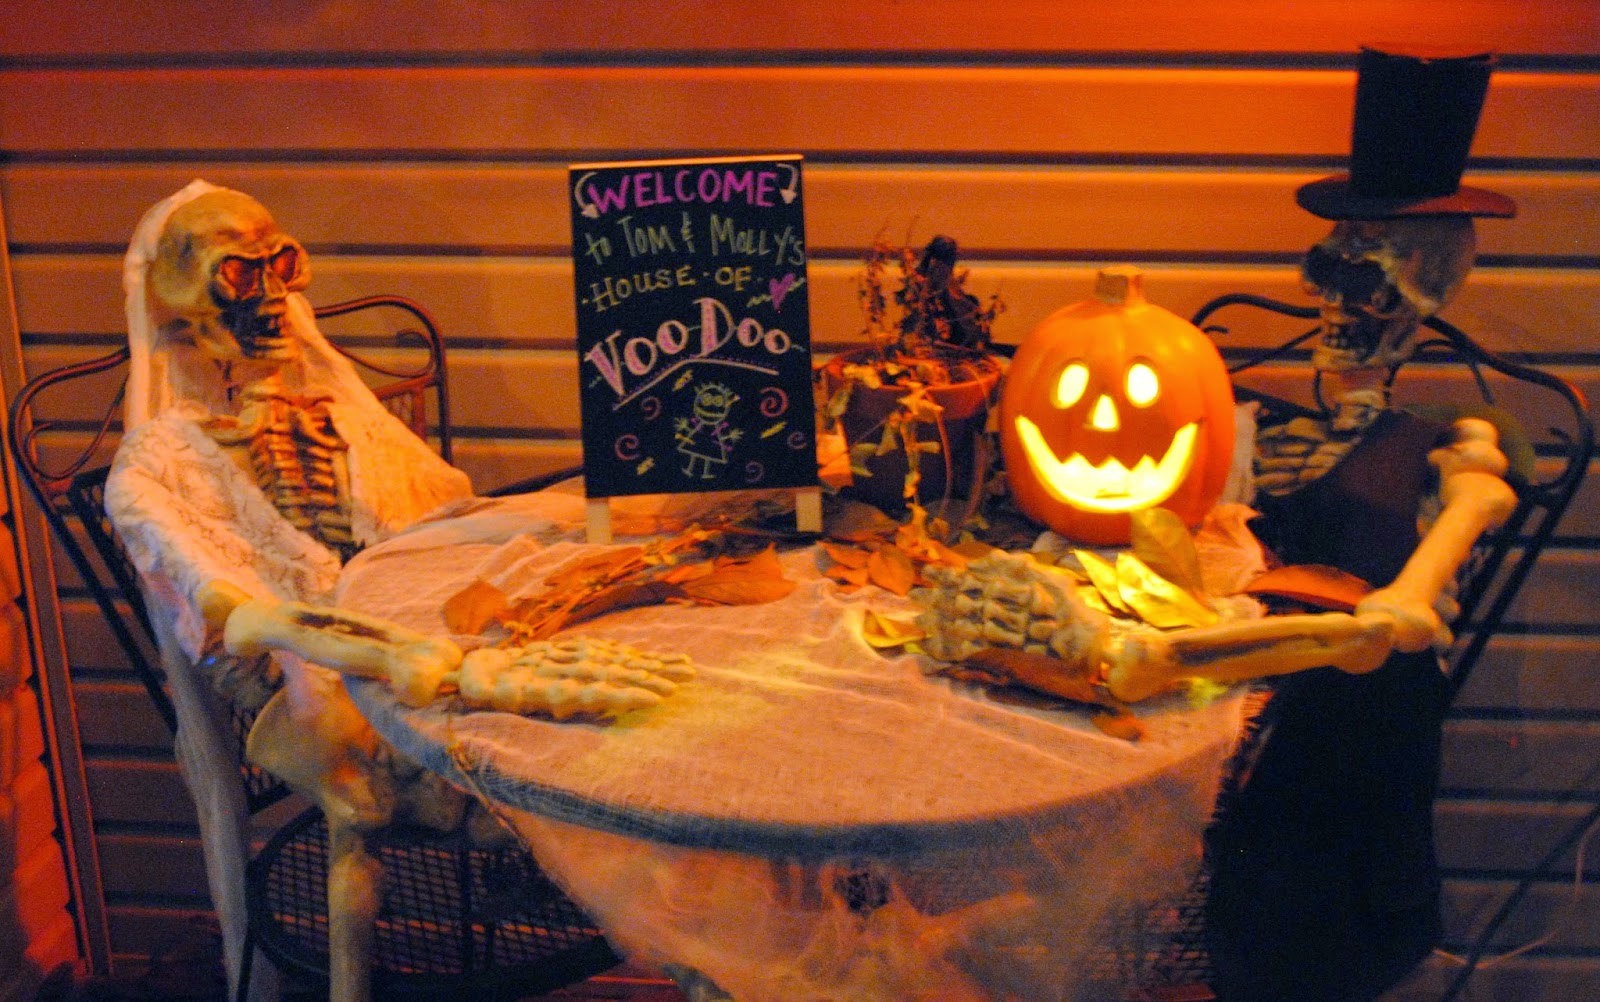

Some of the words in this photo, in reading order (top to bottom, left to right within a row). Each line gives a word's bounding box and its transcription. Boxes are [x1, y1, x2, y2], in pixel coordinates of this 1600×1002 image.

[587, 168, 778, 214] WELCOME
[584, 232, 612, 265] to
[589, 265, 697, 313] HOUSE
[714, 266, 753, 291] OF
